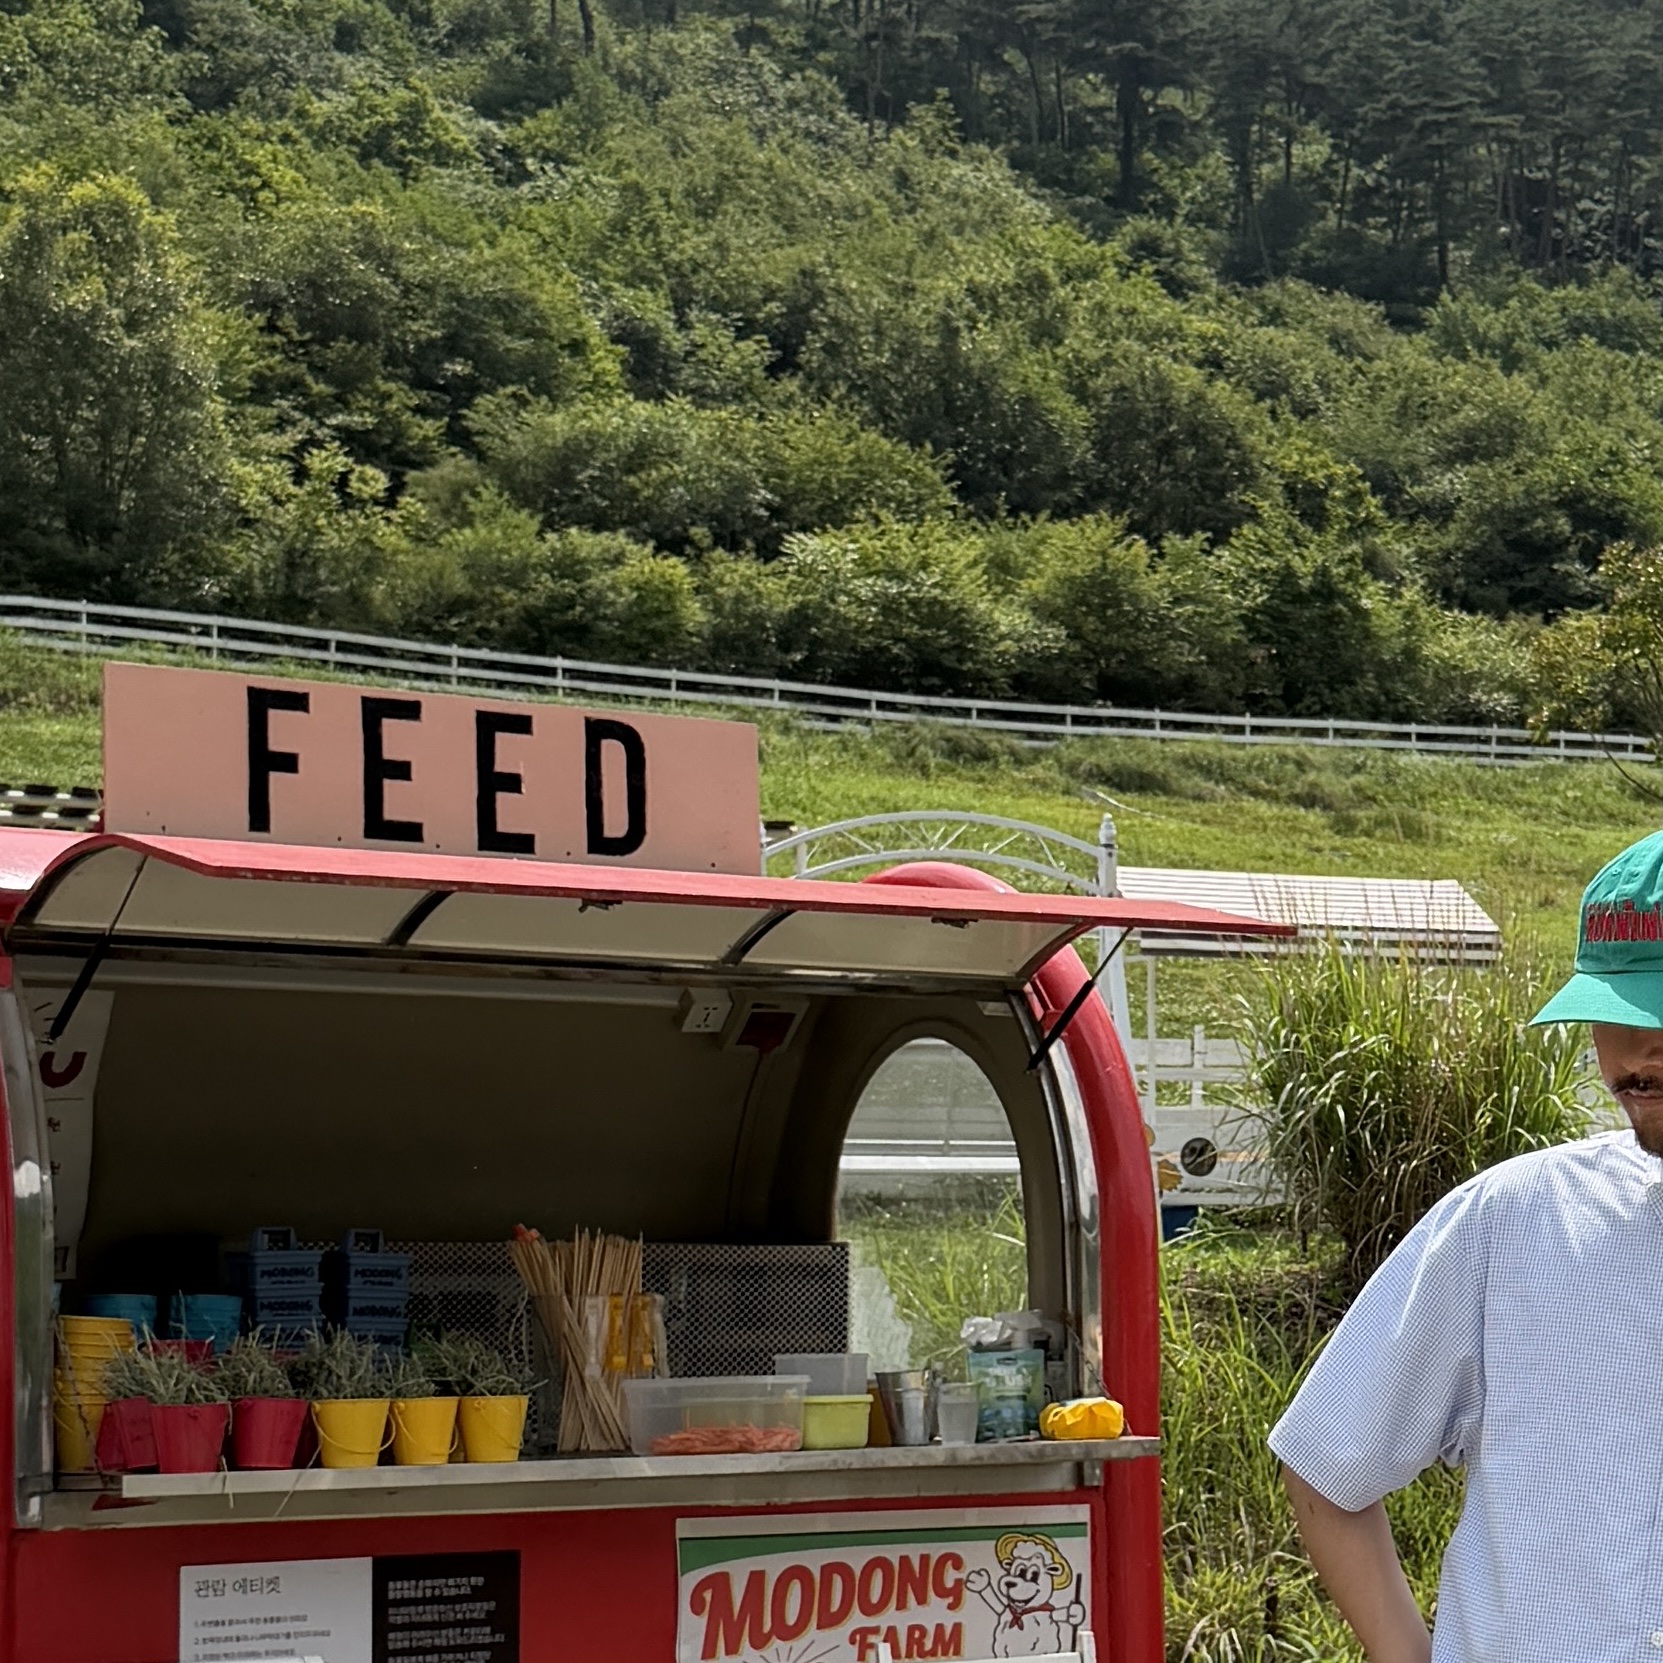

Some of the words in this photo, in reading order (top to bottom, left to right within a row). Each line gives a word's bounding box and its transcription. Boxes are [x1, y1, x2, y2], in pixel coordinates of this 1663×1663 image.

[247, 686, 646, 857] FEED
[232, 1575, 282, 1595] 에티켓
[689, 1552, 963, 1661] MODONG
[848, 1621, 963, 1663] FARM
